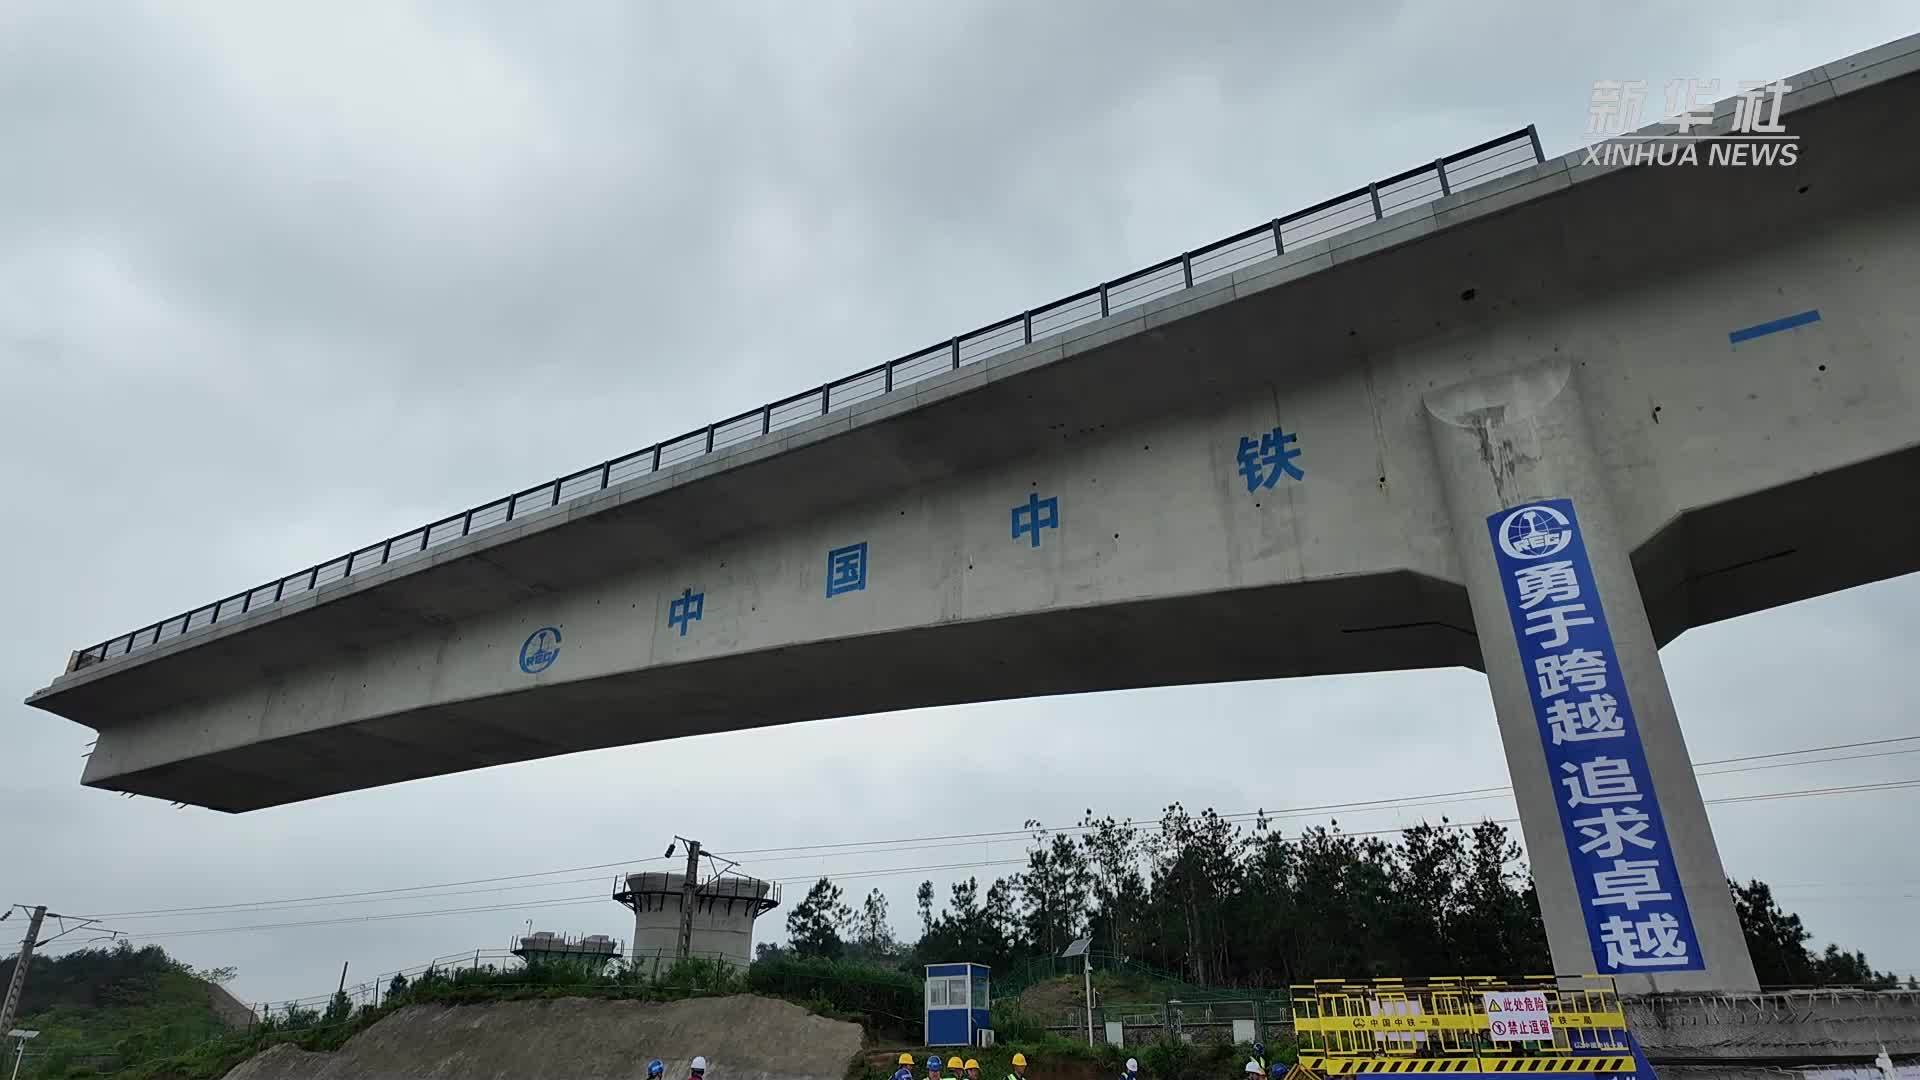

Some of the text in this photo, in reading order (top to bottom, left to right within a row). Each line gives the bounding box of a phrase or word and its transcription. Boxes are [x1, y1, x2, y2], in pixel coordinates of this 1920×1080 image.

[1503, 997, 1546, 1012] 此处危险
[1370, 1017, 1440, 1027] 中国中铁一局
[1507, 1020, 1551, 1035] 禁止逗留
